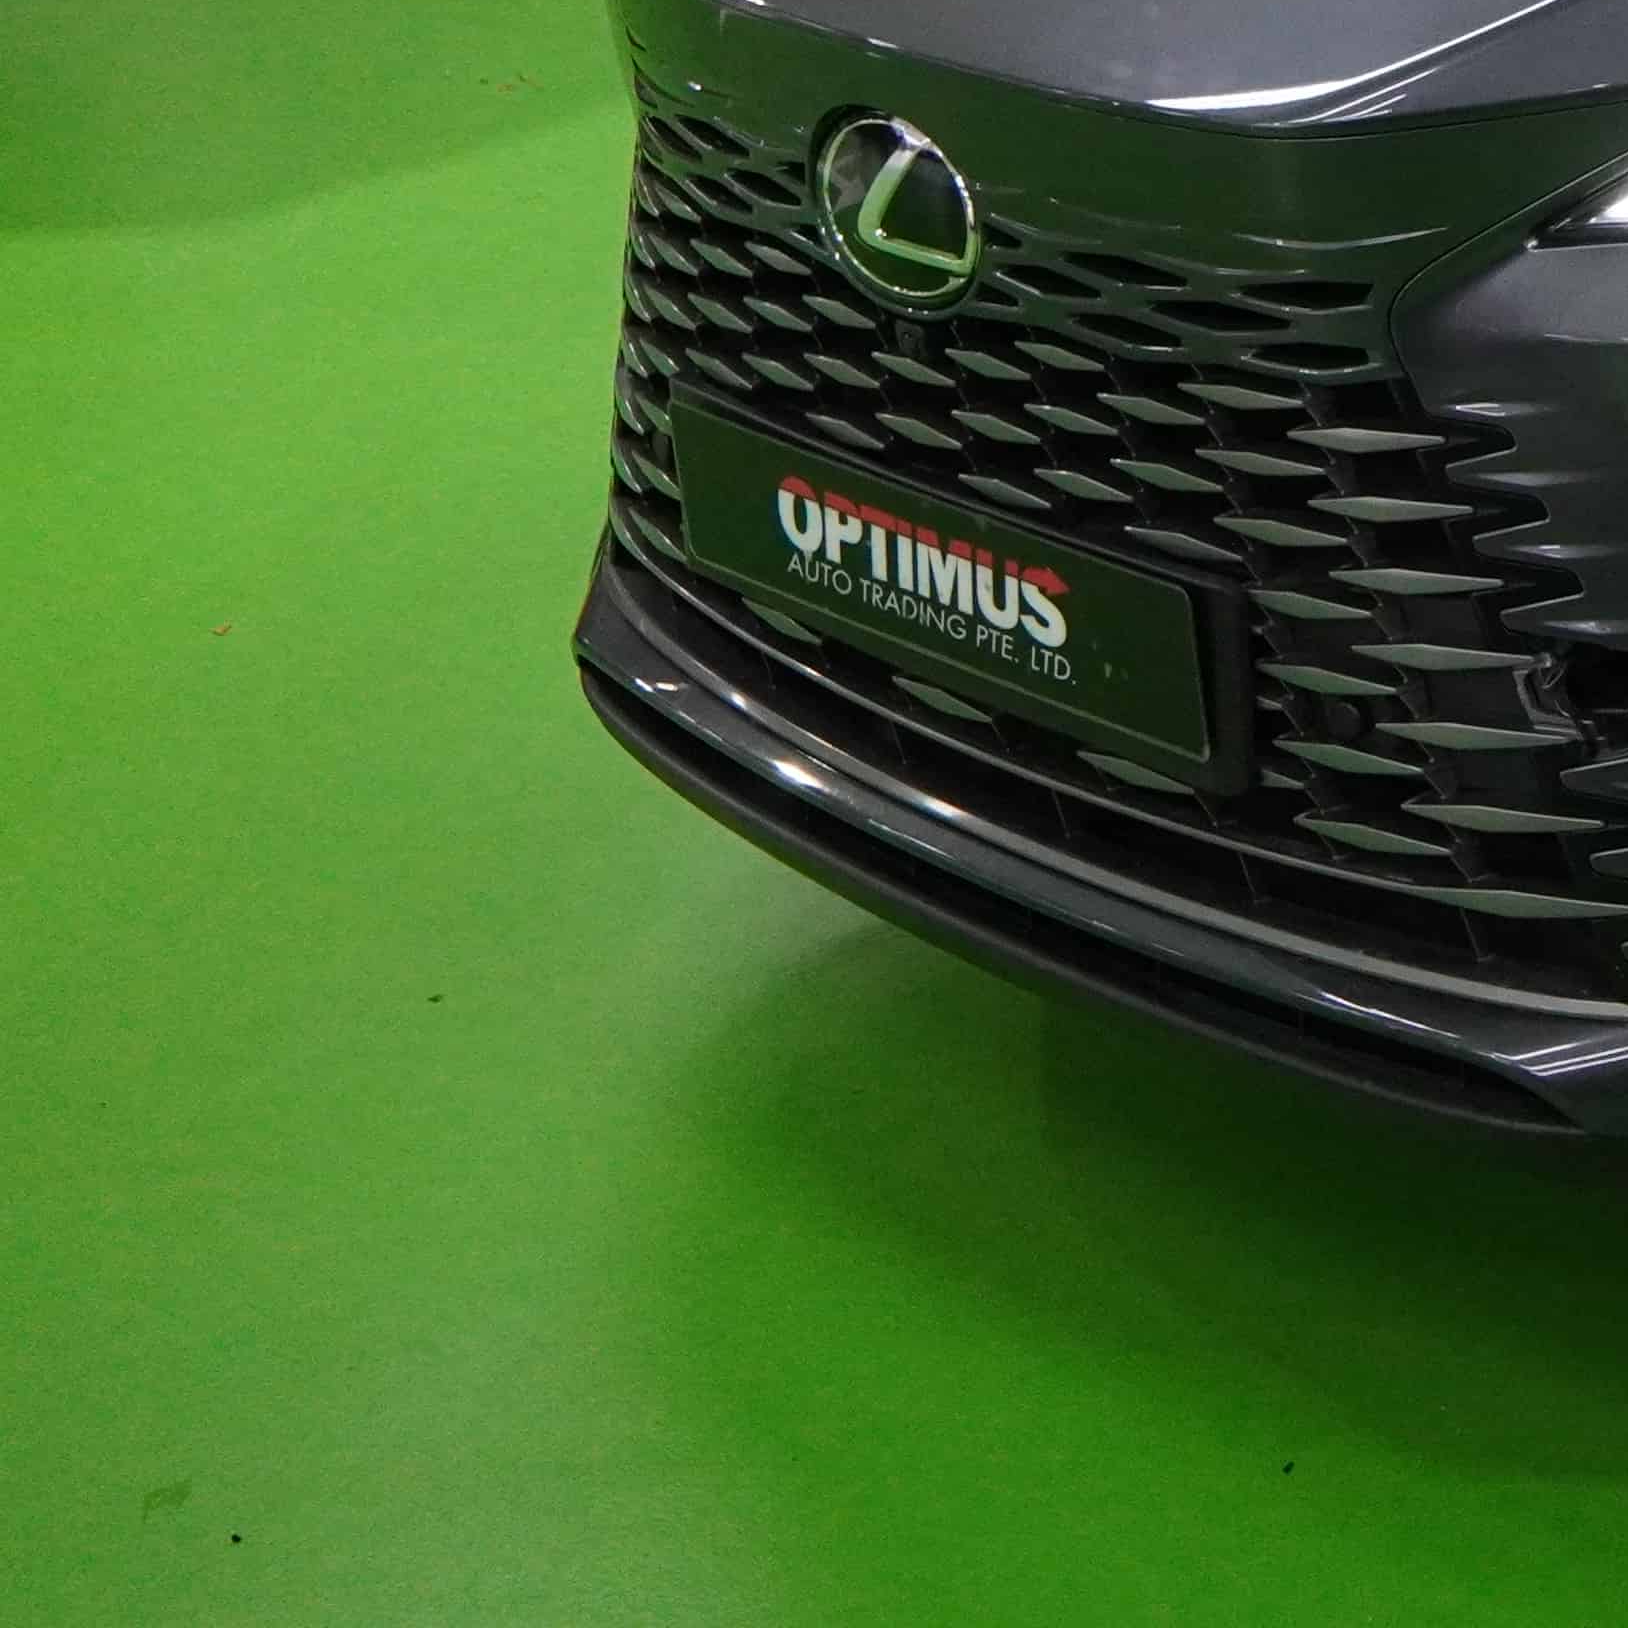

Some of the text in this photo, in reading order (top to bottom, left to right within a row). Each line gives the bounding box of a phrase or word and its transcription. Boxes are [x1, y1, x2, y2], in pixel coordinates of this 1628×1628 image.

[777, 474, 1070, 649] OPTIMUS
[787, 552, 1077, 686] AUTO TRADING PTE. LTD.
